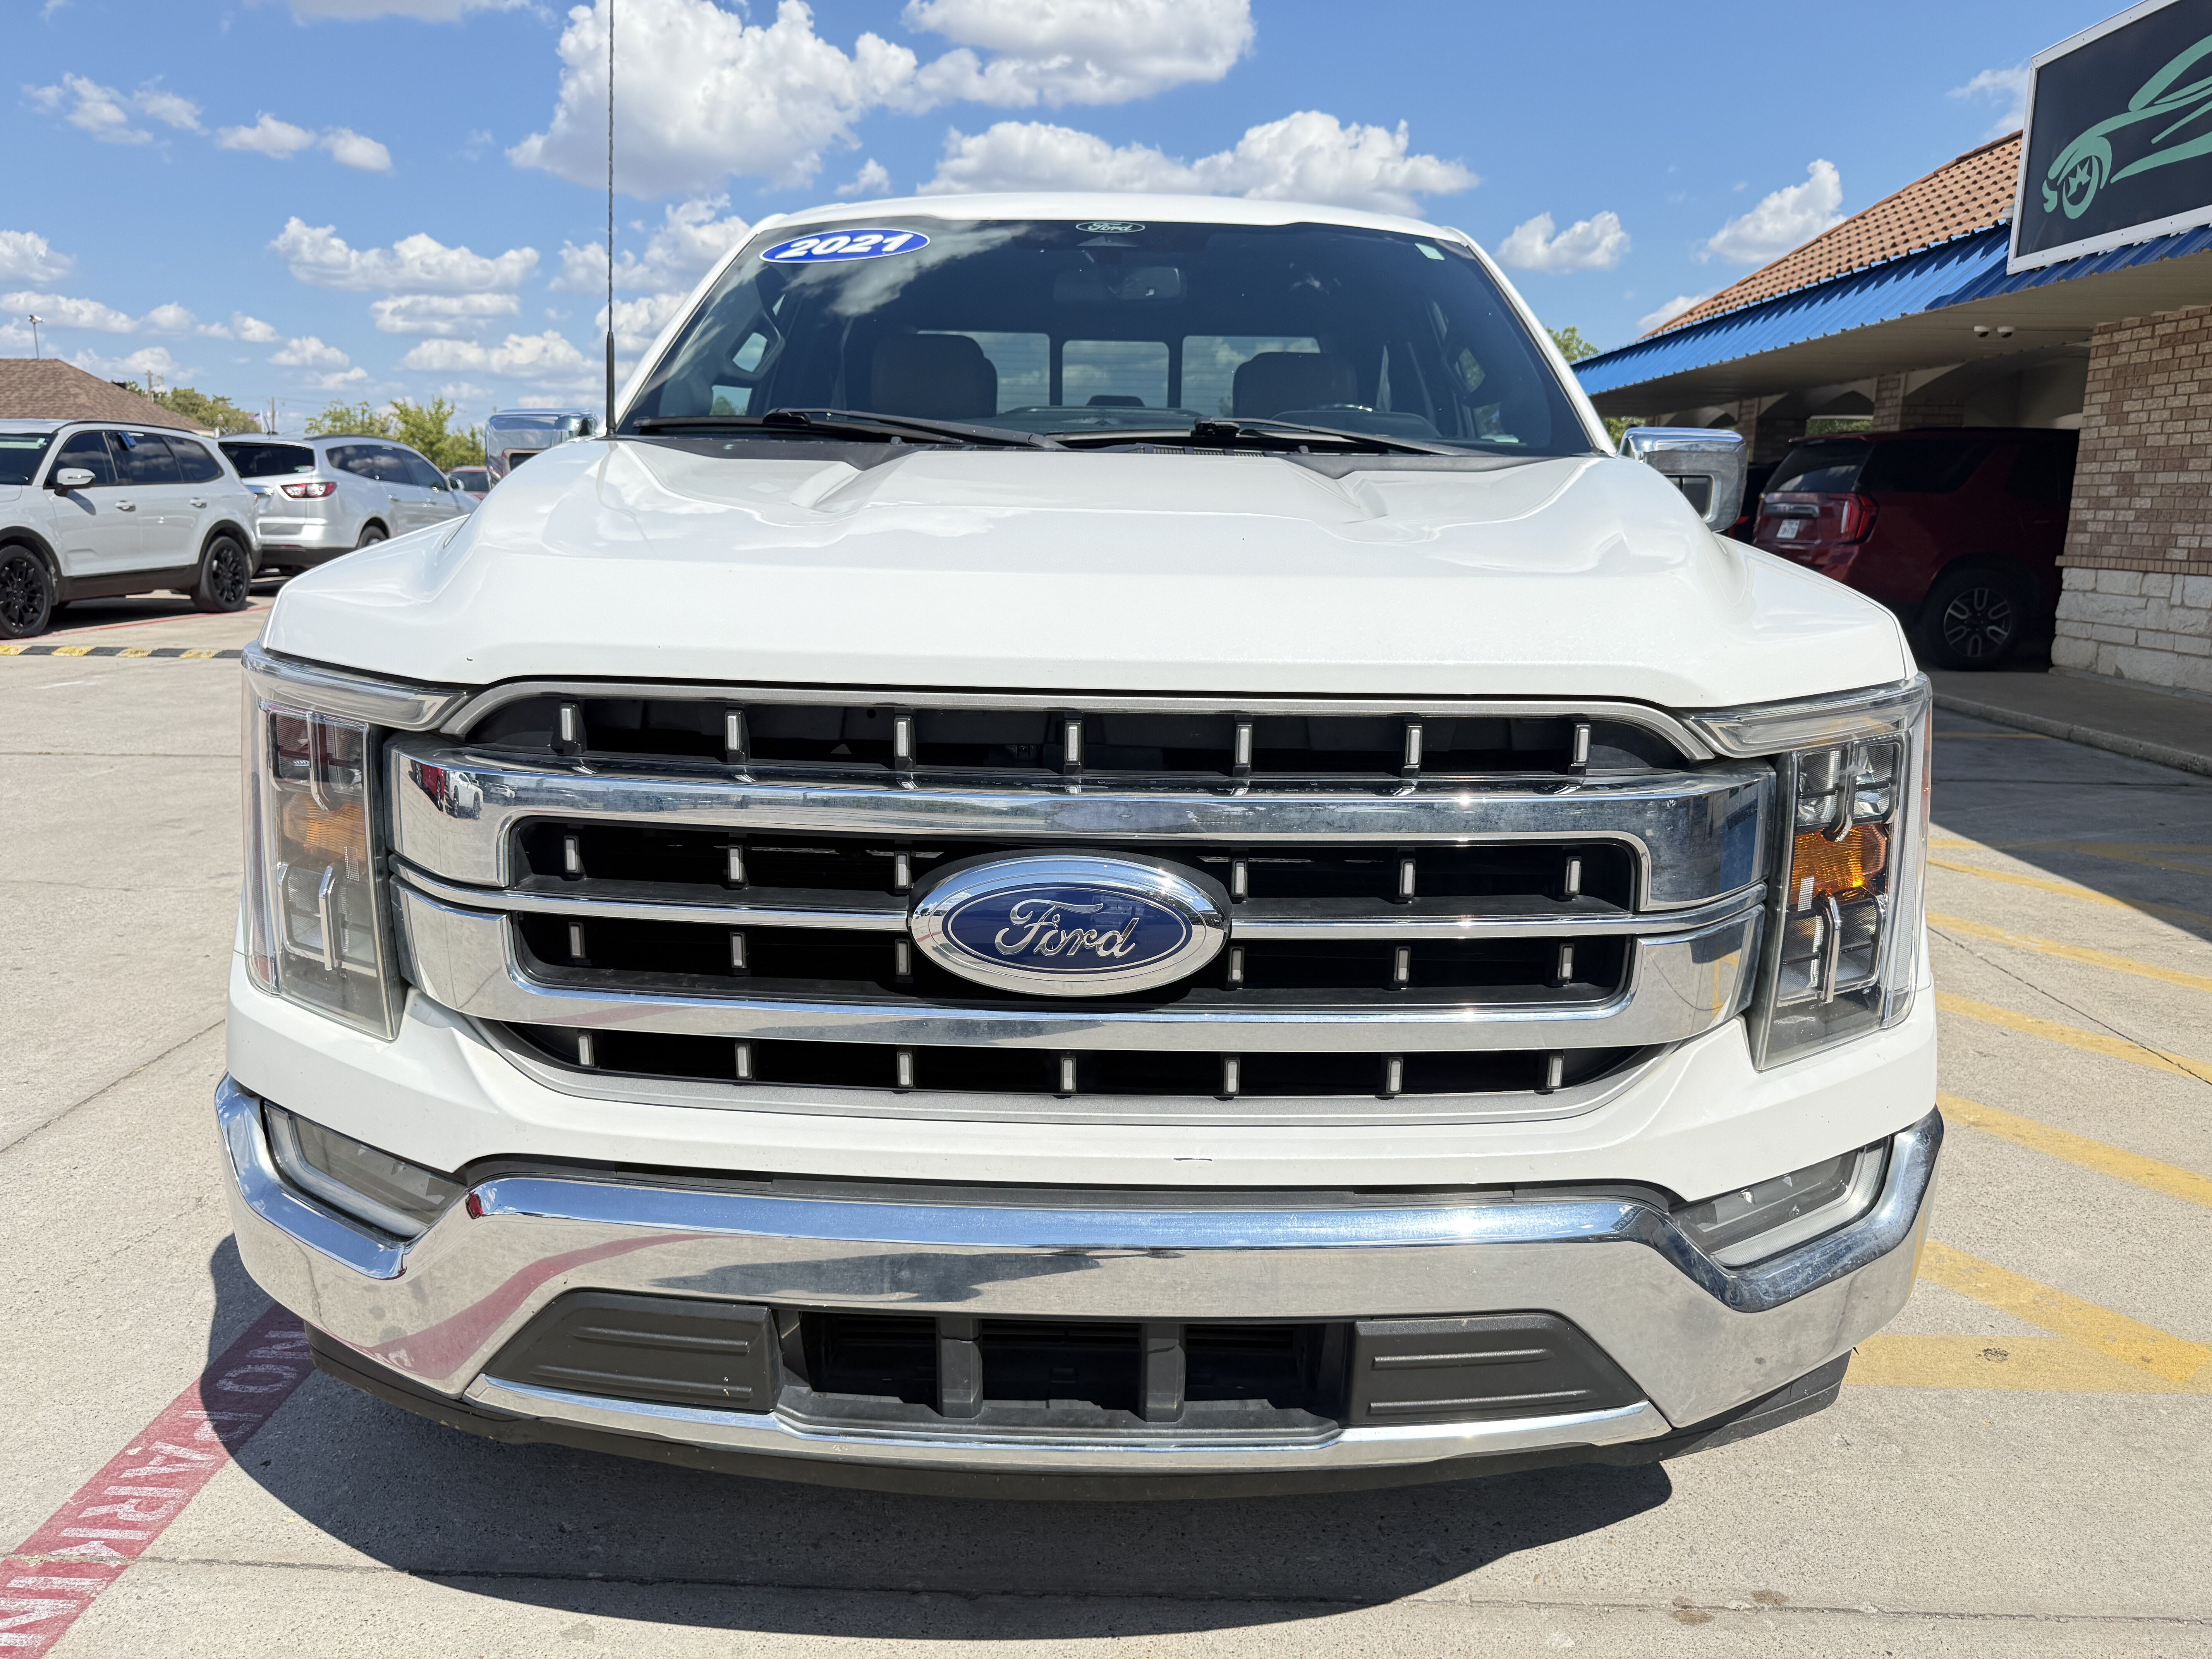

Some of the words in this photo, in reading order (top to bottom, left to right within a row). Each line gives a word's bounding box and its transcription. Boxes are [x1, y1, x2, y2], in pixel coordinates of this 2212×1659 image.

[1088, 223, 1133, 231] Ford
[775, 234, 914, 259] 2021
[995, 898, 1139, 958] Ford
